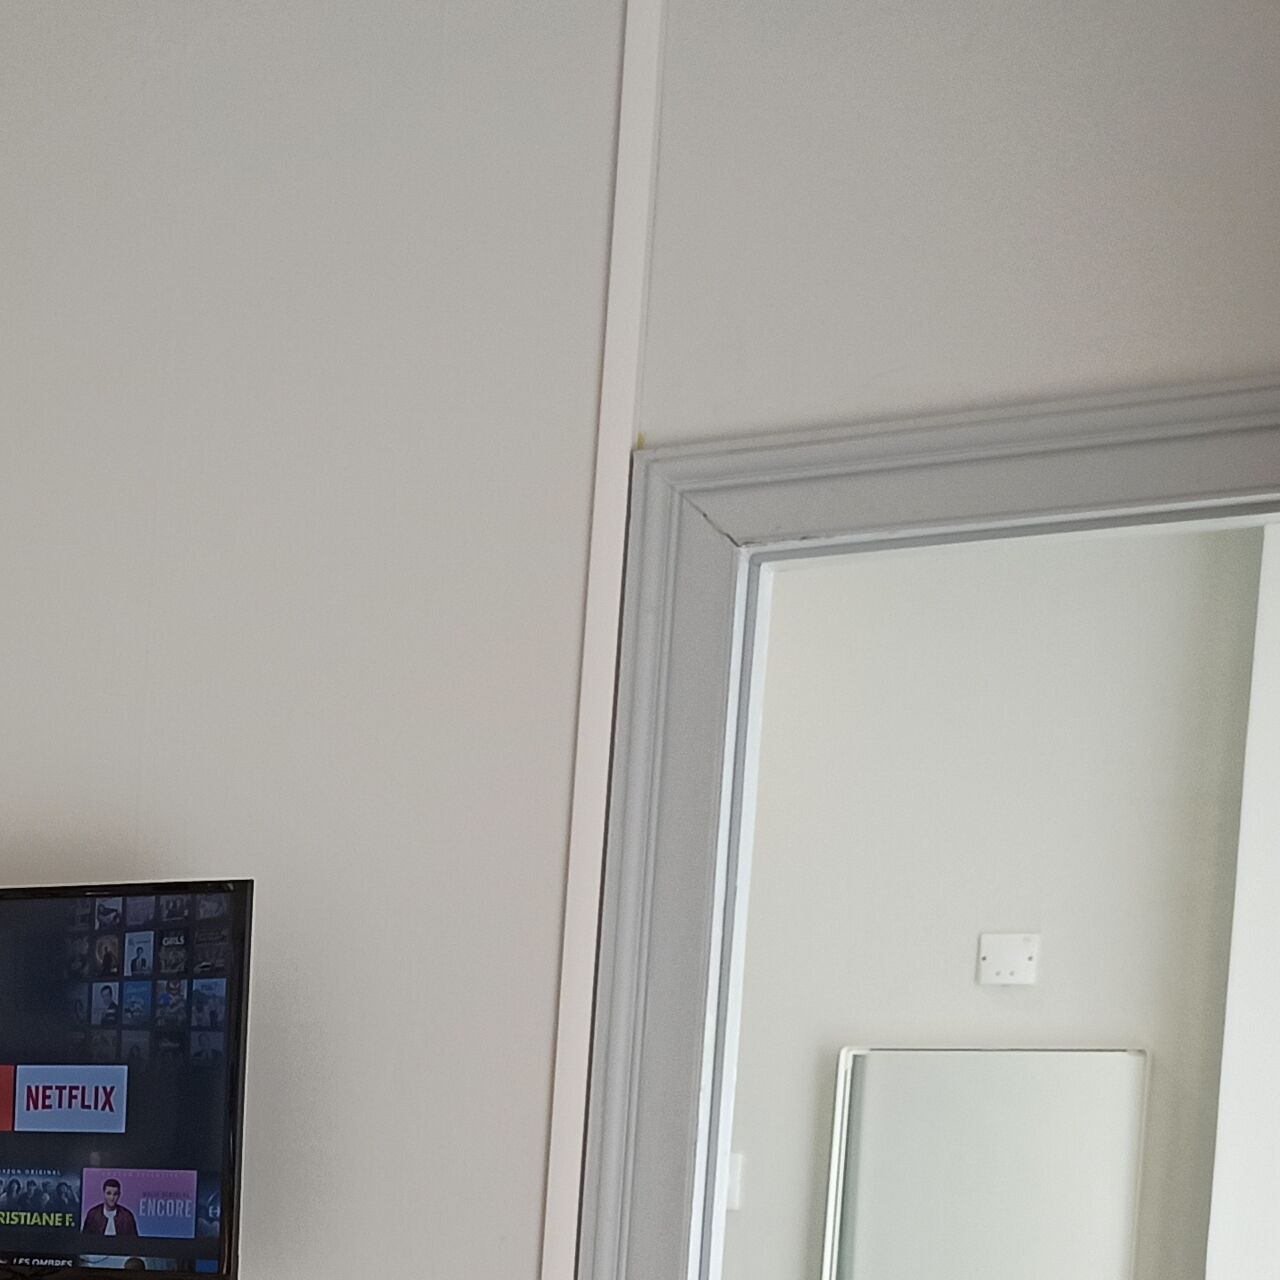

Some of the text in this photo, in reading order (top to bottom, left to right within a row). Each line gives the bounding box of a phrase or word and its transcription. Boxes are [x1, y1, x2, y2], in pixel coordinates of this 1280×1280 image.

[25, 1084, 116, 1112] NETFLIX
[139, 1198, 192, 1219] ENCORE
[65, 1213, 76, 1228] F.
